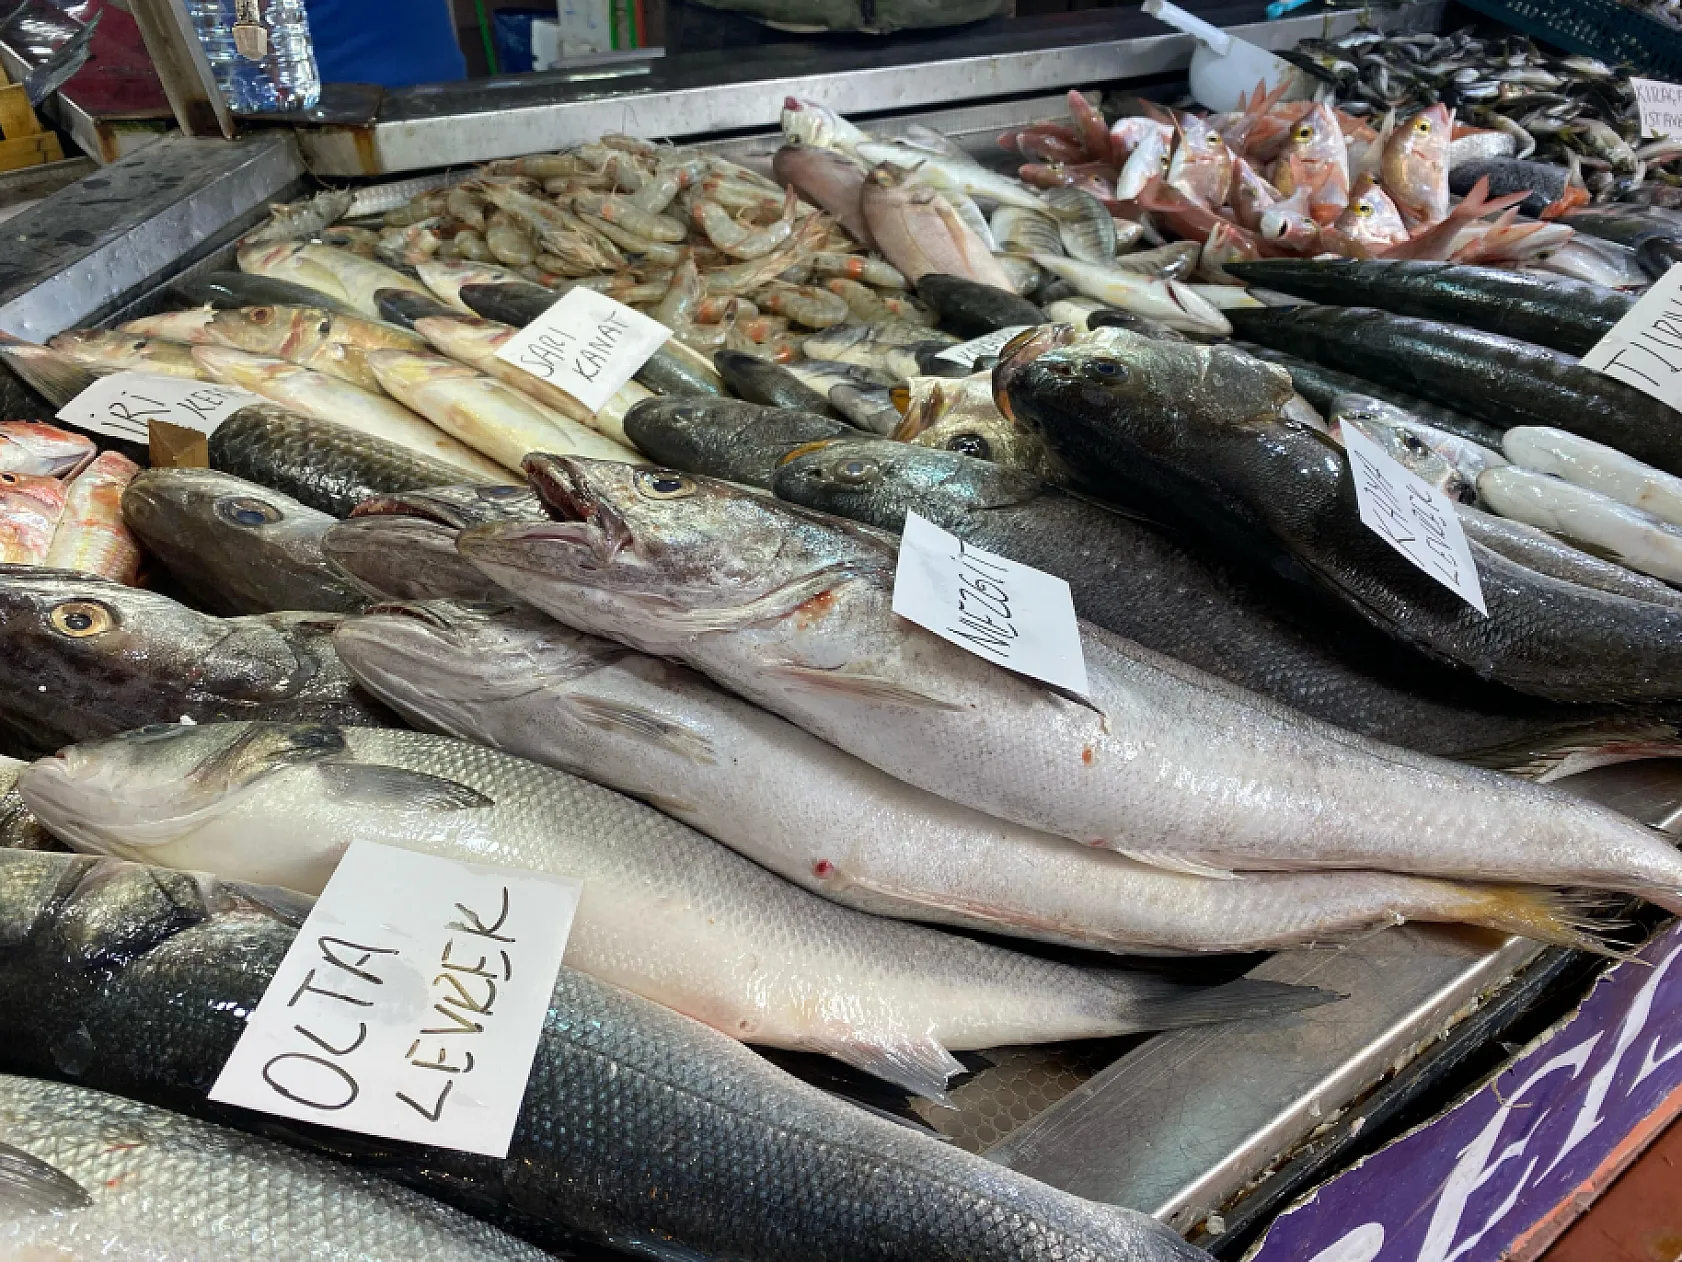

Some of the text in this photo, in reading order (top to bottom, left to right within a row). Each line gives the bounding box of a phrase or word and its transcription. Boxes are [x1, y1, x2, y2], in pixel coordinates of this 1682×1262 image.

[520, 326, 577, 378] SARI
[571, 310, 629, 384] KANAT
[1353, 450, 1426, 568] KAYA
[262, 935, 400, 1111] OLTA
[395, 886, 516, 1123] LEVREK
